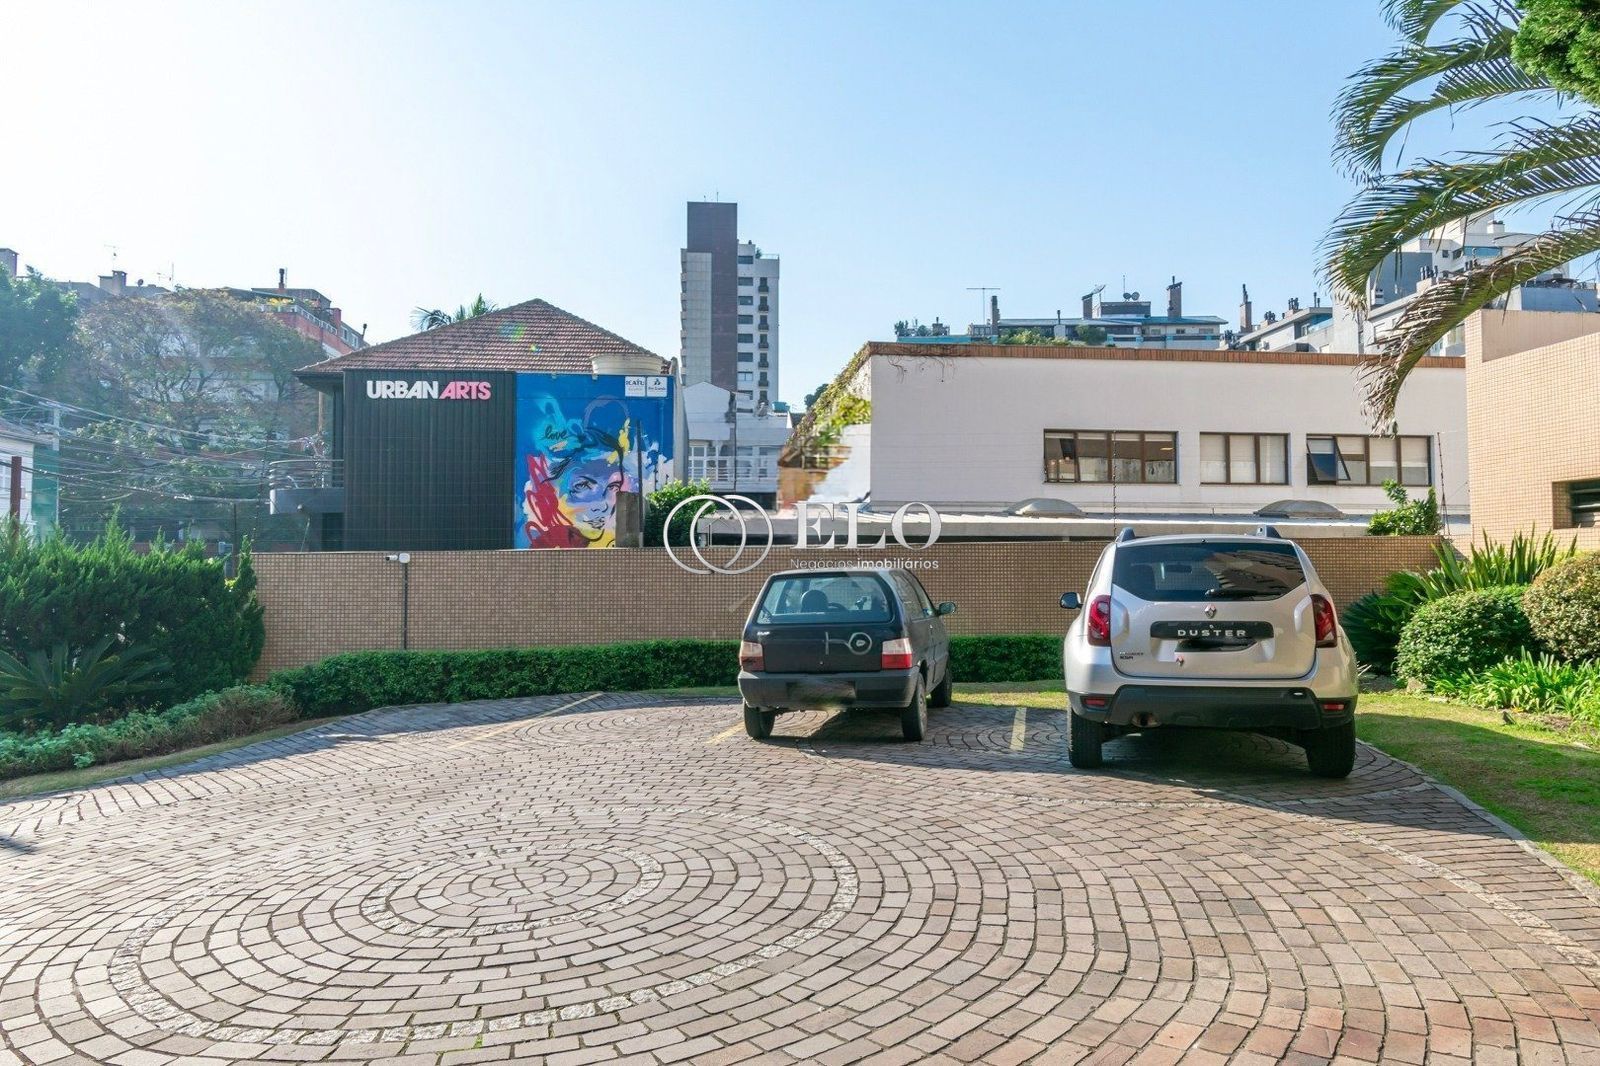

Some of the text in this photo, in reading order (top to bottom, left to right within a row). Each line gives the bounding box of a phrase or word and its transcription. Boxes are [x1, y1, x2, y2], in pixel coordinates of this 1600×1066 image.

[366, 380, 492, 400] URBAN ARTS
[544, 425, 568, 440] love
[1177, 629, 1246, 637] DUSTER
